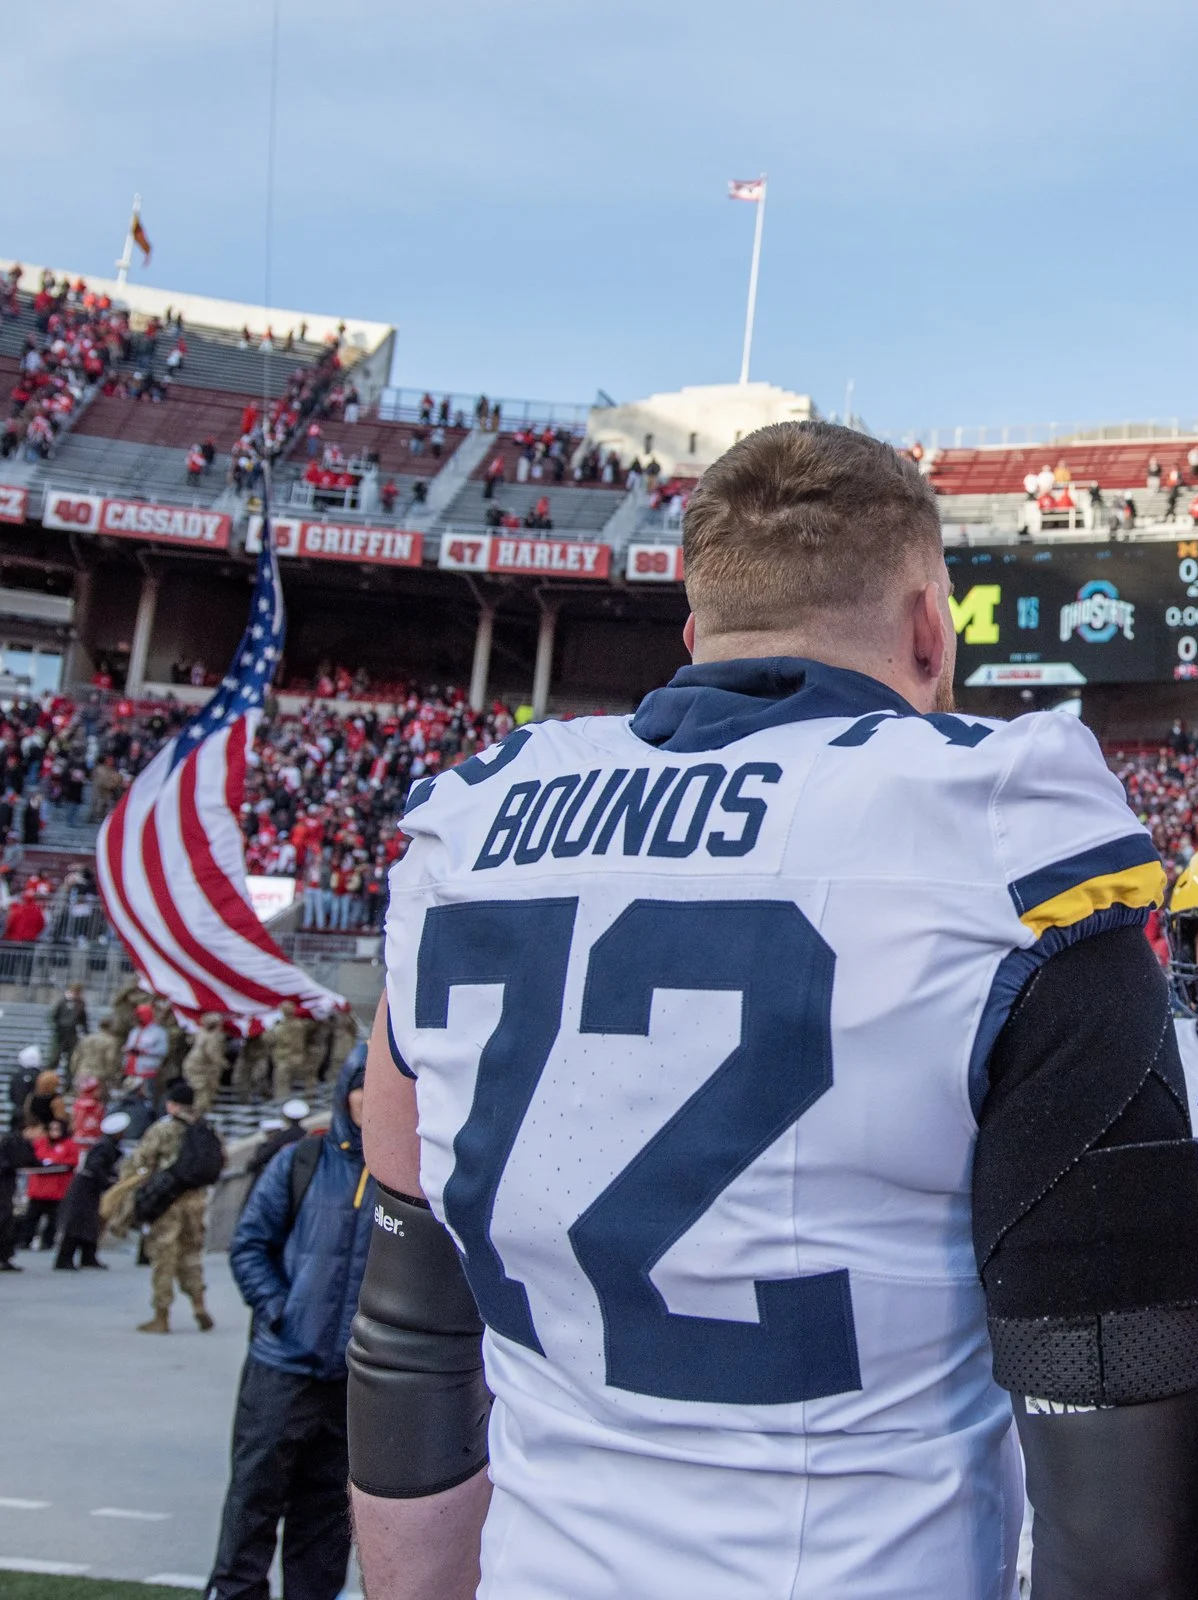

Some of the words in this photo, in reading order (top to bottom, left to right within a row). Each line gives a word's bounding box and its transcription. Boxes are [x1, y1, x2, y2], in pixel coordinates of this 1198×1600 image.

[55, 500, 91, 525] 40
[104, 503, 222, 541] CASSADY
[305, 526, 412, 560] GRIFFIN
[449, 541, 483, 563] 47
[497, 540, 599, 572] HARLEY
[1177, 635, 1198, 662] 0
[471, 762, 784, 872] BOUNDS
[415, 896, 864, 1406] 72
